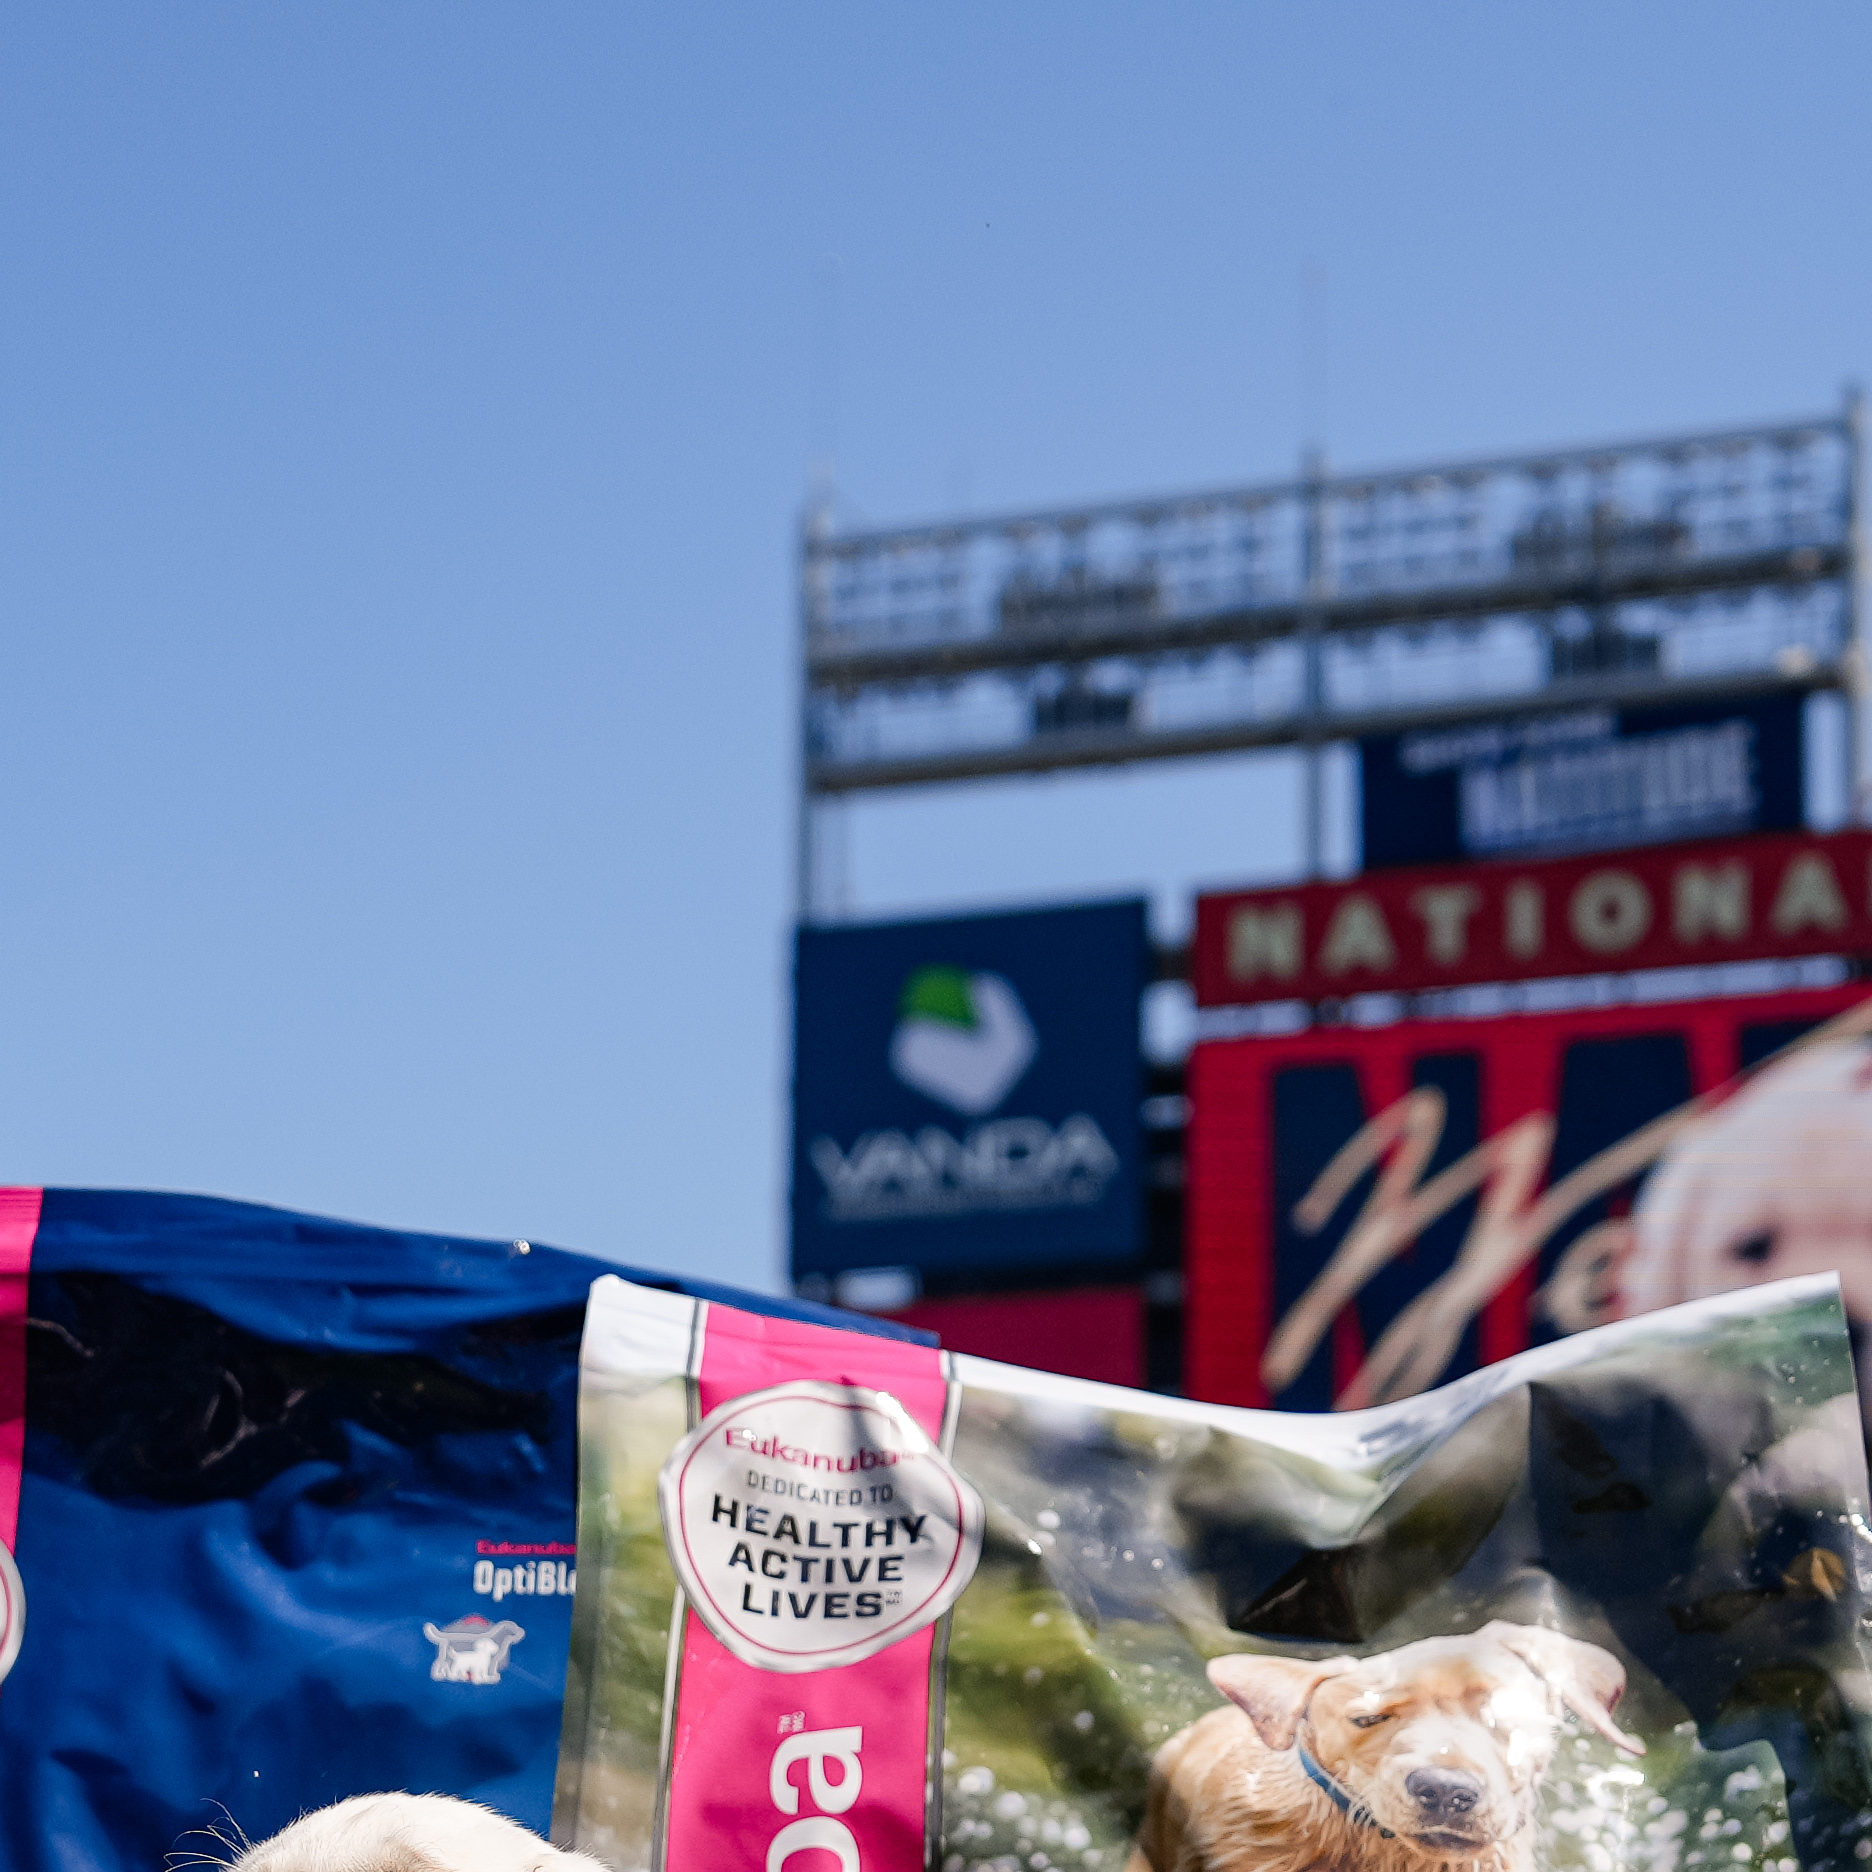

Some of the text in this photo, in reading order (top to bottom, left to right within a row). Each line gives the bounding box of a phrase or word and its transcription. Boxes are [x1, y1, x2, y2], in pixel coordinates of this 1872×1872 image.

[808, 1112, 1120, 1202] VANDA
[725, 1427, 899, 1474] Eukanuba
[747, 1469, 894, 1506] DEDICATED TO
[711, 1492, 928, 1548] HEALTHY
[728, 1542, 905, 1584] ACTIVE
[741, 1581, 885, 1619] LIVES
